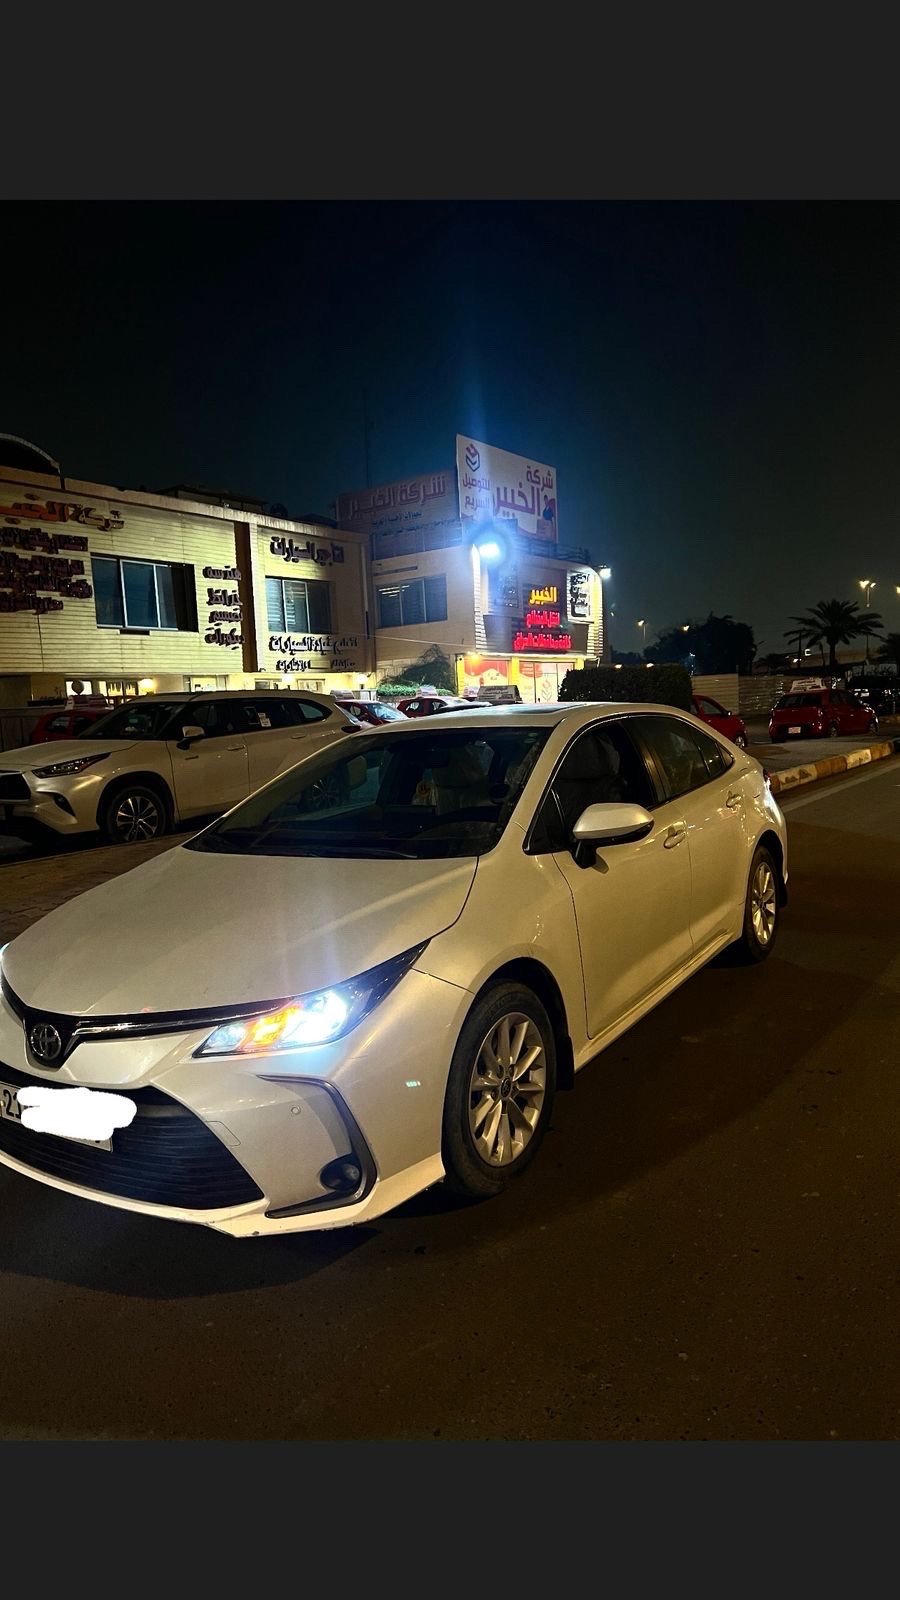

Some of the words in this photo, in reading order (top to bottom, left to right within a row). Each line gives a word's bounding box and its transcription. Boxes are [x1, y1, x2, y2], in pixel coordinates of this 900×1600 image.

[400, 474, 448, 505] شركة
[462, 473, 490, 492] للتوصيل
[527, 465, 554, 492] شركة
[493, 482, 541, 518] الخبير
[270, 536, 315, 563] السيارات
[529, 586, 557, 606] الخبير
[268, 636, 312, 655] السيارات
